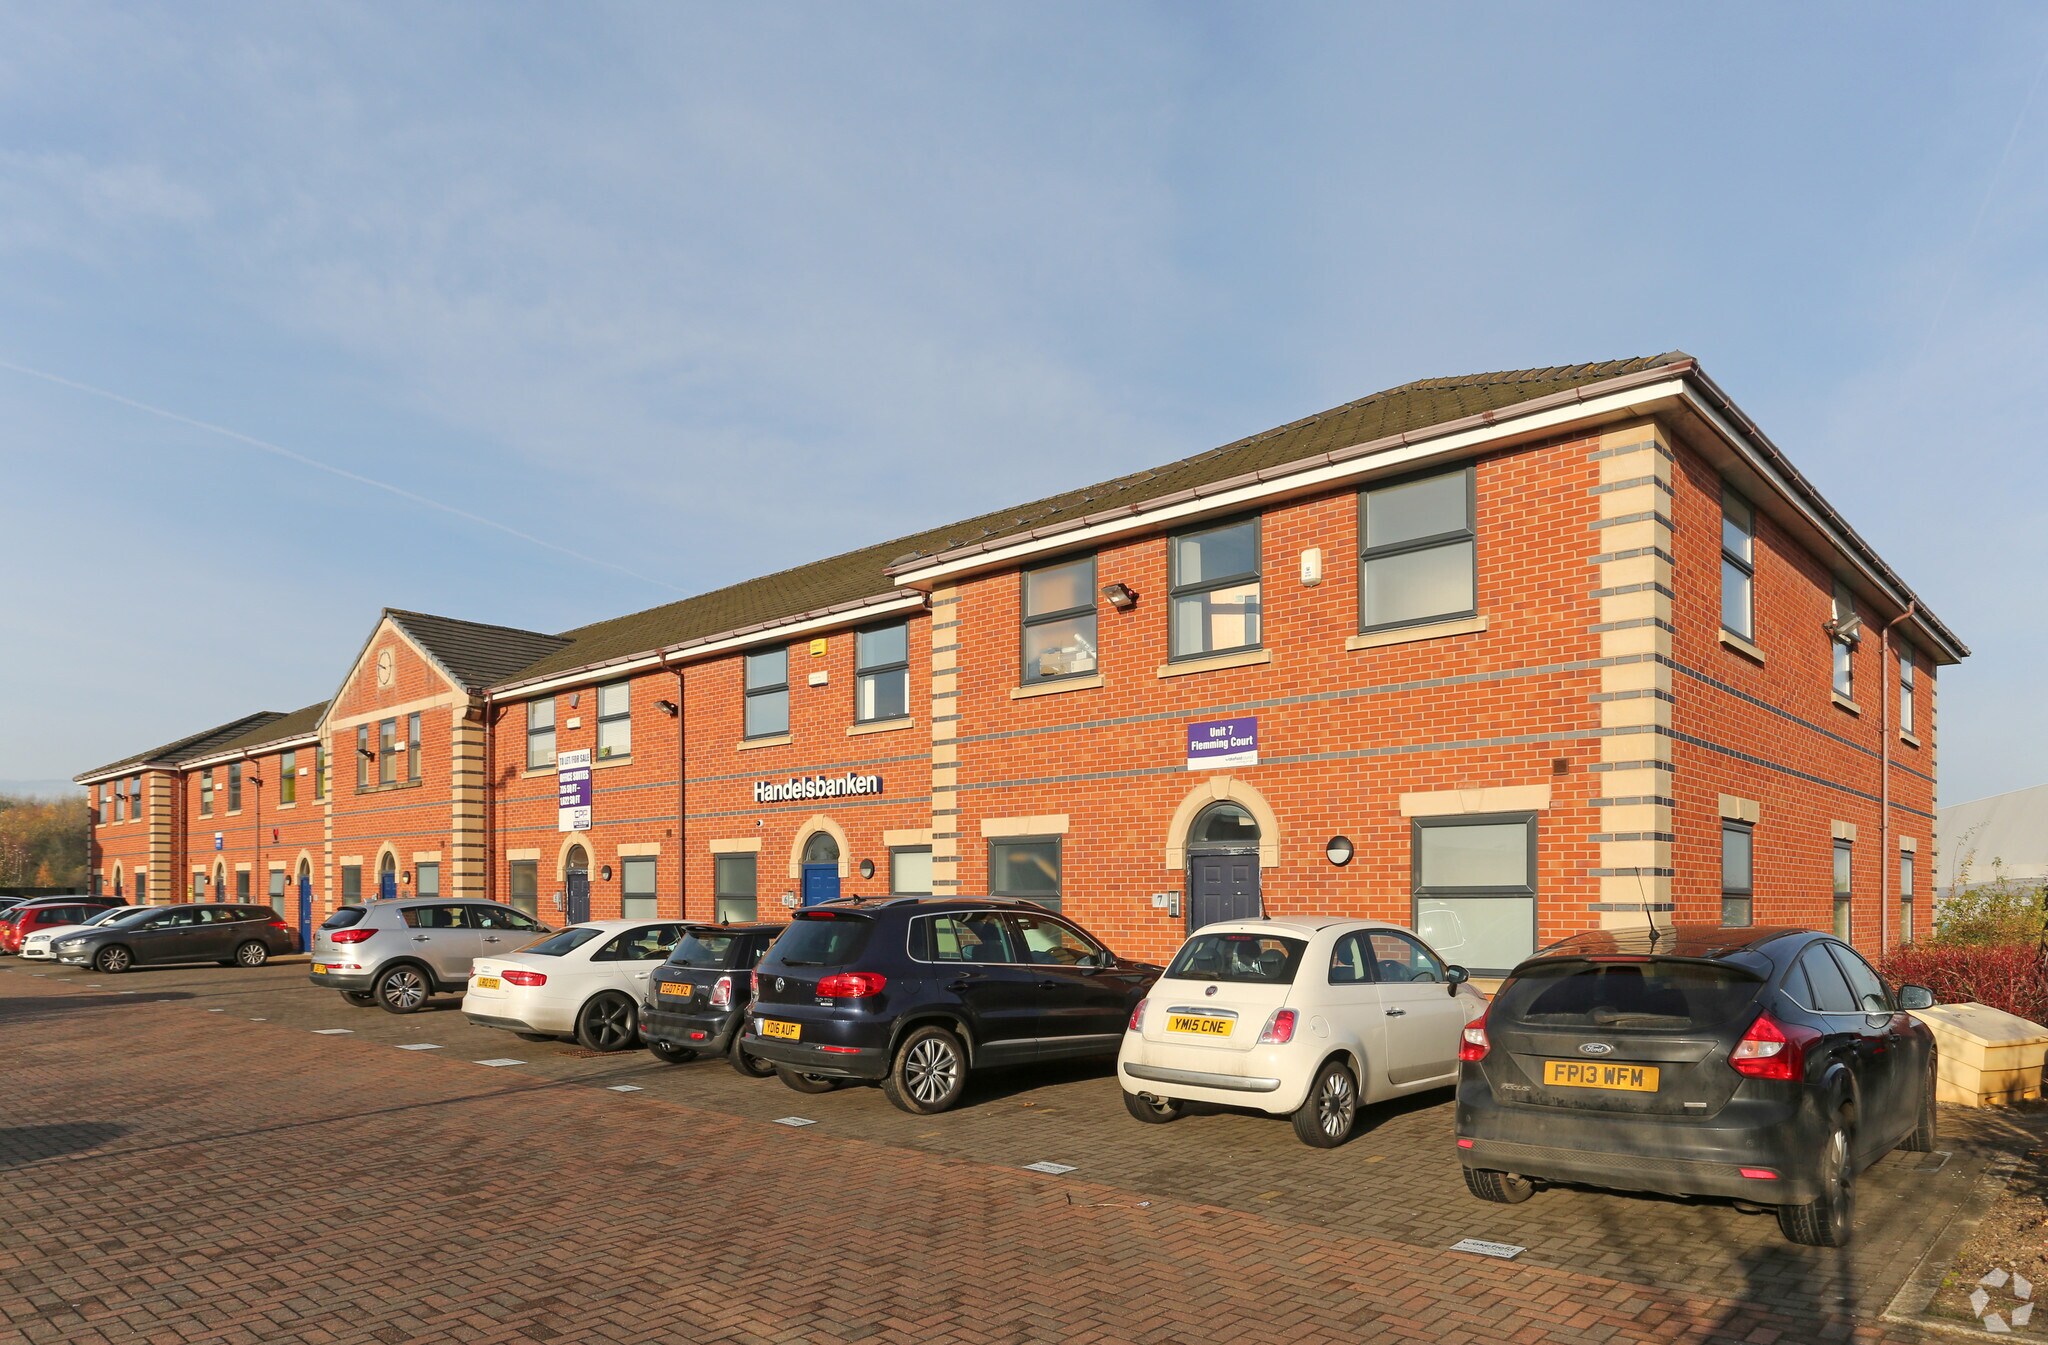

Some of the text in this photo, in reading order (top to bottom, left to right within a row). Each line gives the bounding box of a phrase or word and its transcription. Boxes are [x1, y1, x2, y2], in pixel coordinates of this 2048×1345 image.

[1209, 725, 1234, 738] Unit 7
[1191, 735, 1254, 751] Flemming Court
[754, 772, 879, 802] Handelsbanken
[1156, 894, 1163, 906] 7
[766, 1022, 796, 1036] YD16 AUF
[1175, 1018, 1226, 1034] YM15 CNE
[1585, 1044, 1604, 1052] Ford
[1554, 1064, 1644, 1087] FP13 WFM
